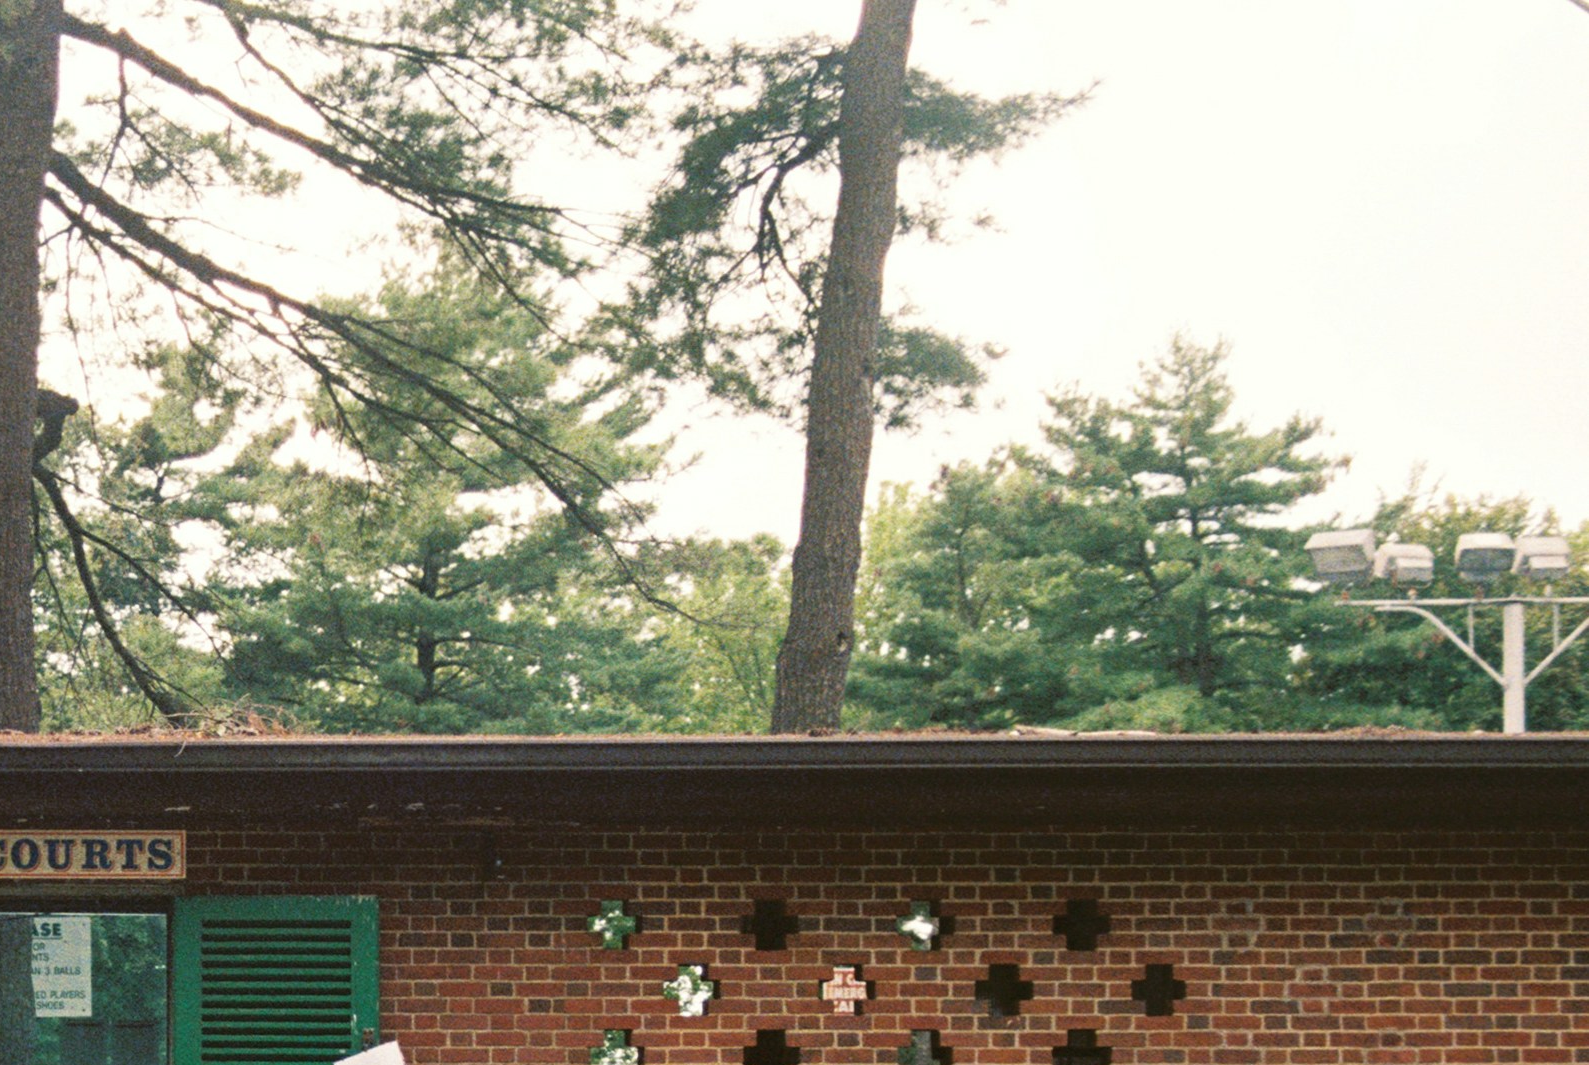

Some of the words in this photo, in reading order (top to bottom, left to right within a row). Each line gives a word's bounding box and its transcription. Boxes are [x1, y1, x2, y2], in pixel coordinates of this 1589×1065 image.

[31, 922, 62, 937] ASE
[31, 953, 50, 961] NTS
[54, 966, 82, 976] BALLS
[35, 990, 47, 999] ED
[49, 990, 87, 999] PLAYERS
